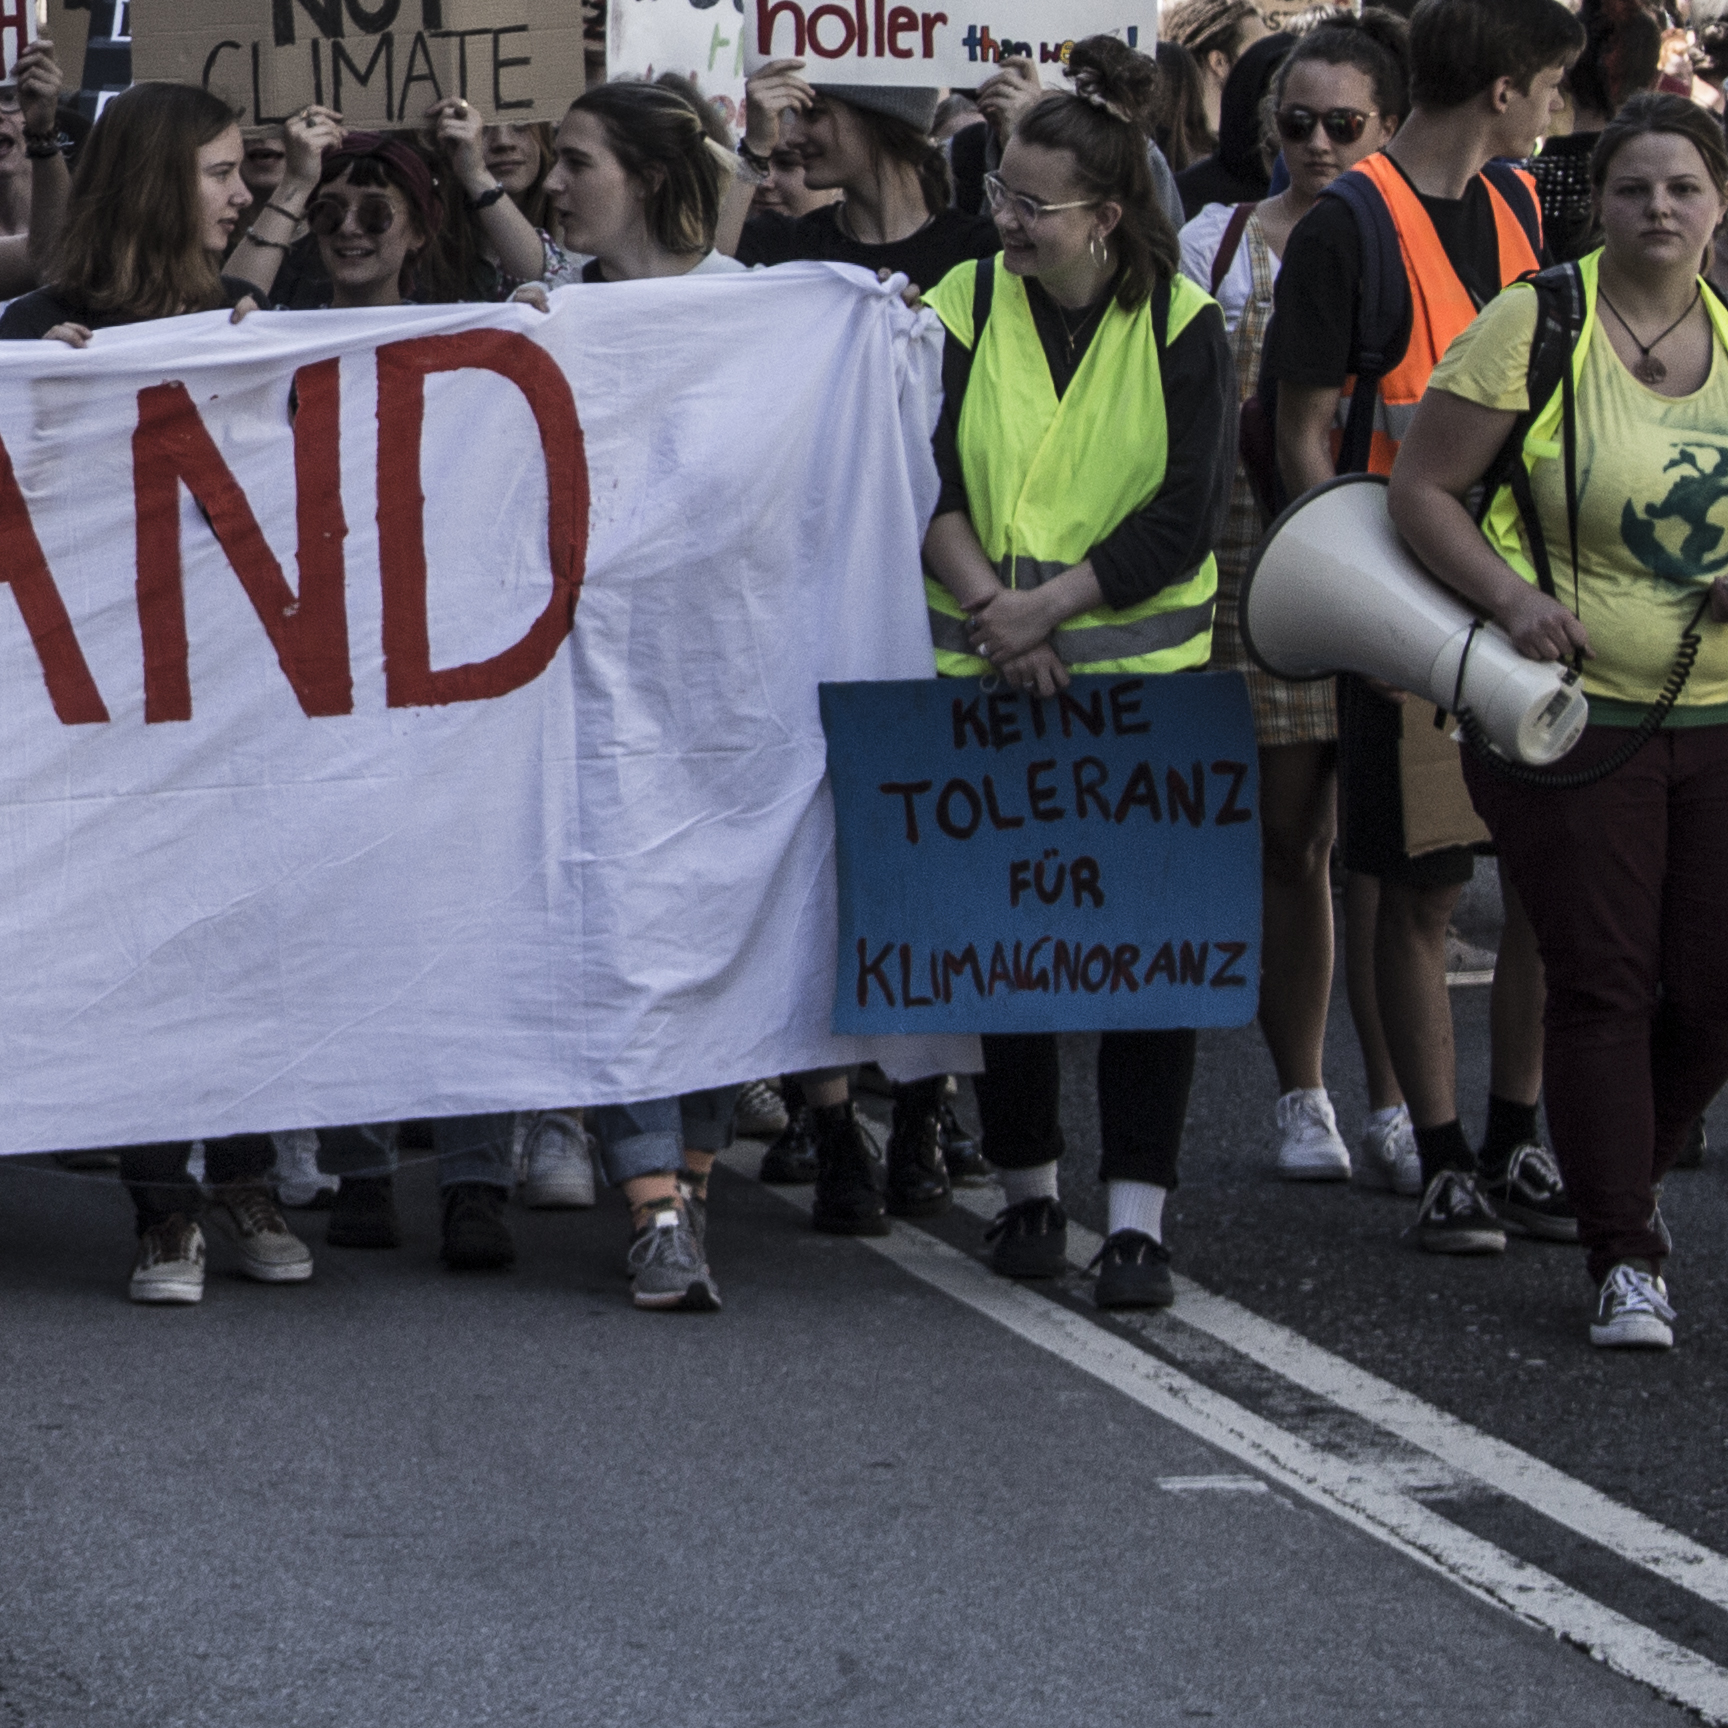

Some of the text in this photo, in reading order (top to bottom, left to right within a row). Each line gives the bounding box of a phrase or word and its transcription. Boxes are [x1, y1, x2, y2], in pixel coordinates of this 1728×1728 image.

[201, 23, 533, 127] CLIMATE
[952, 678, 1152, 750] KEINE
[879, 755, 1252, 844] TOLERANZ
[1009, 848, 1105, 908] FÜR
[855, 935, 1248, 1009] KLIMAIGNORANZ
